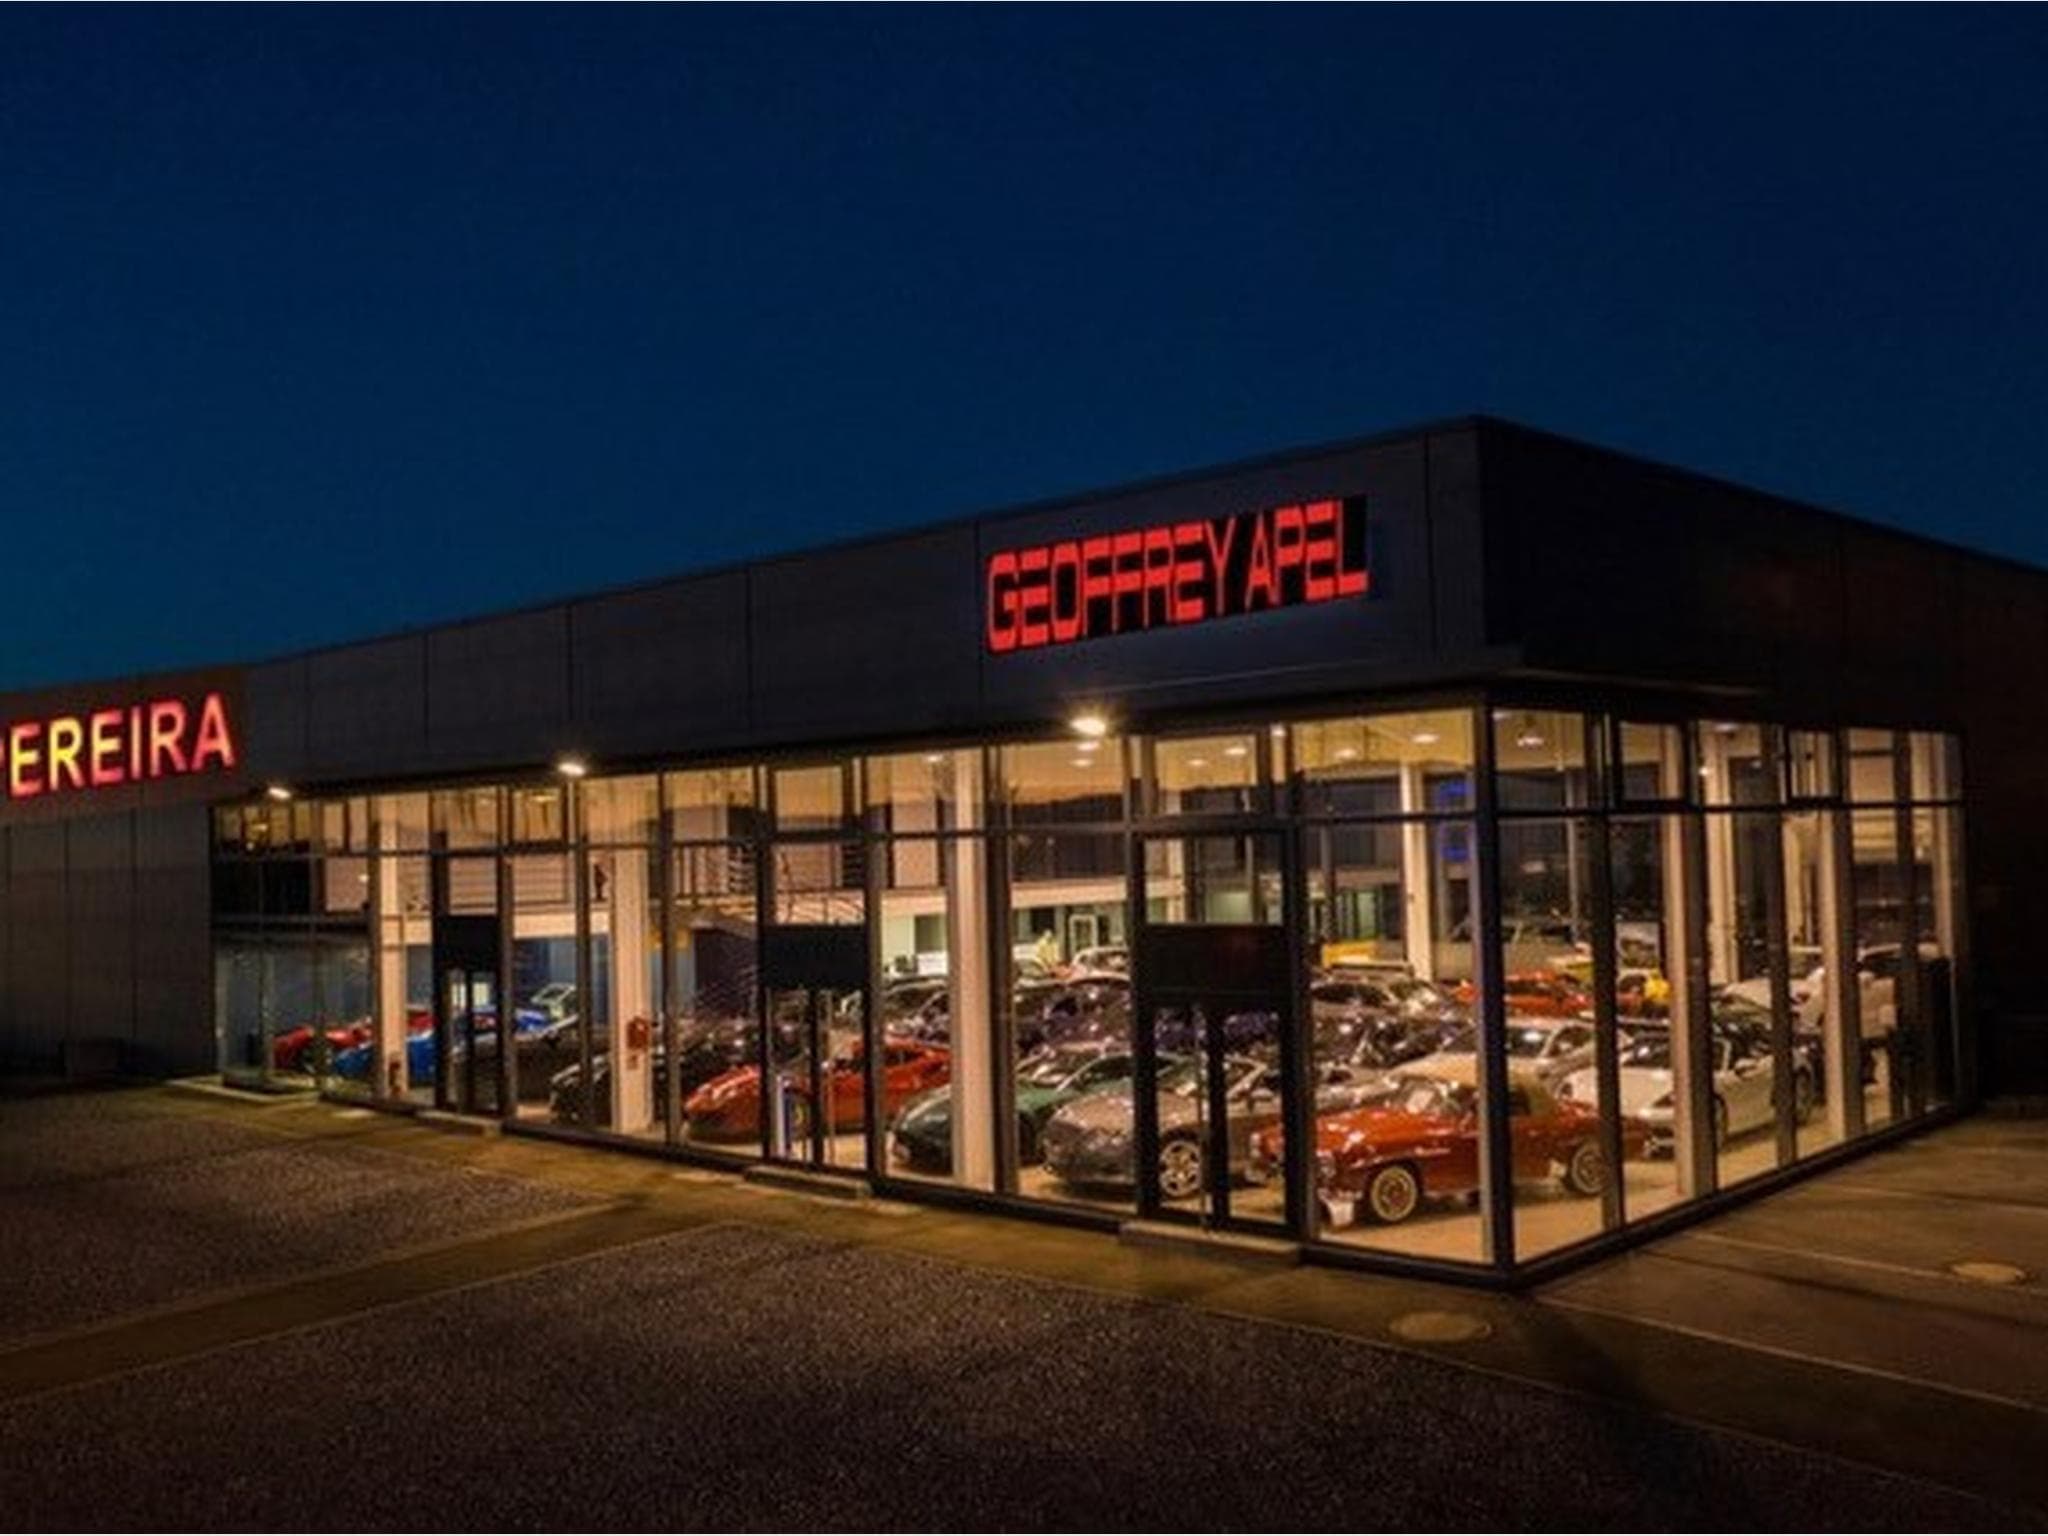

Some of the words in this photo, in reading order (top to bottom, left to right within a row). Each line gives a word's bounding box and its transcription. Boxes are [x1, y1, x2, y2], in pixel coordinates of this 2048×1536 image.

[987, 517, 1236, 651] GEOFFREY
[1246, 500, 1368, 610] APEL
[0, 693, 234, 797] EREIRA
